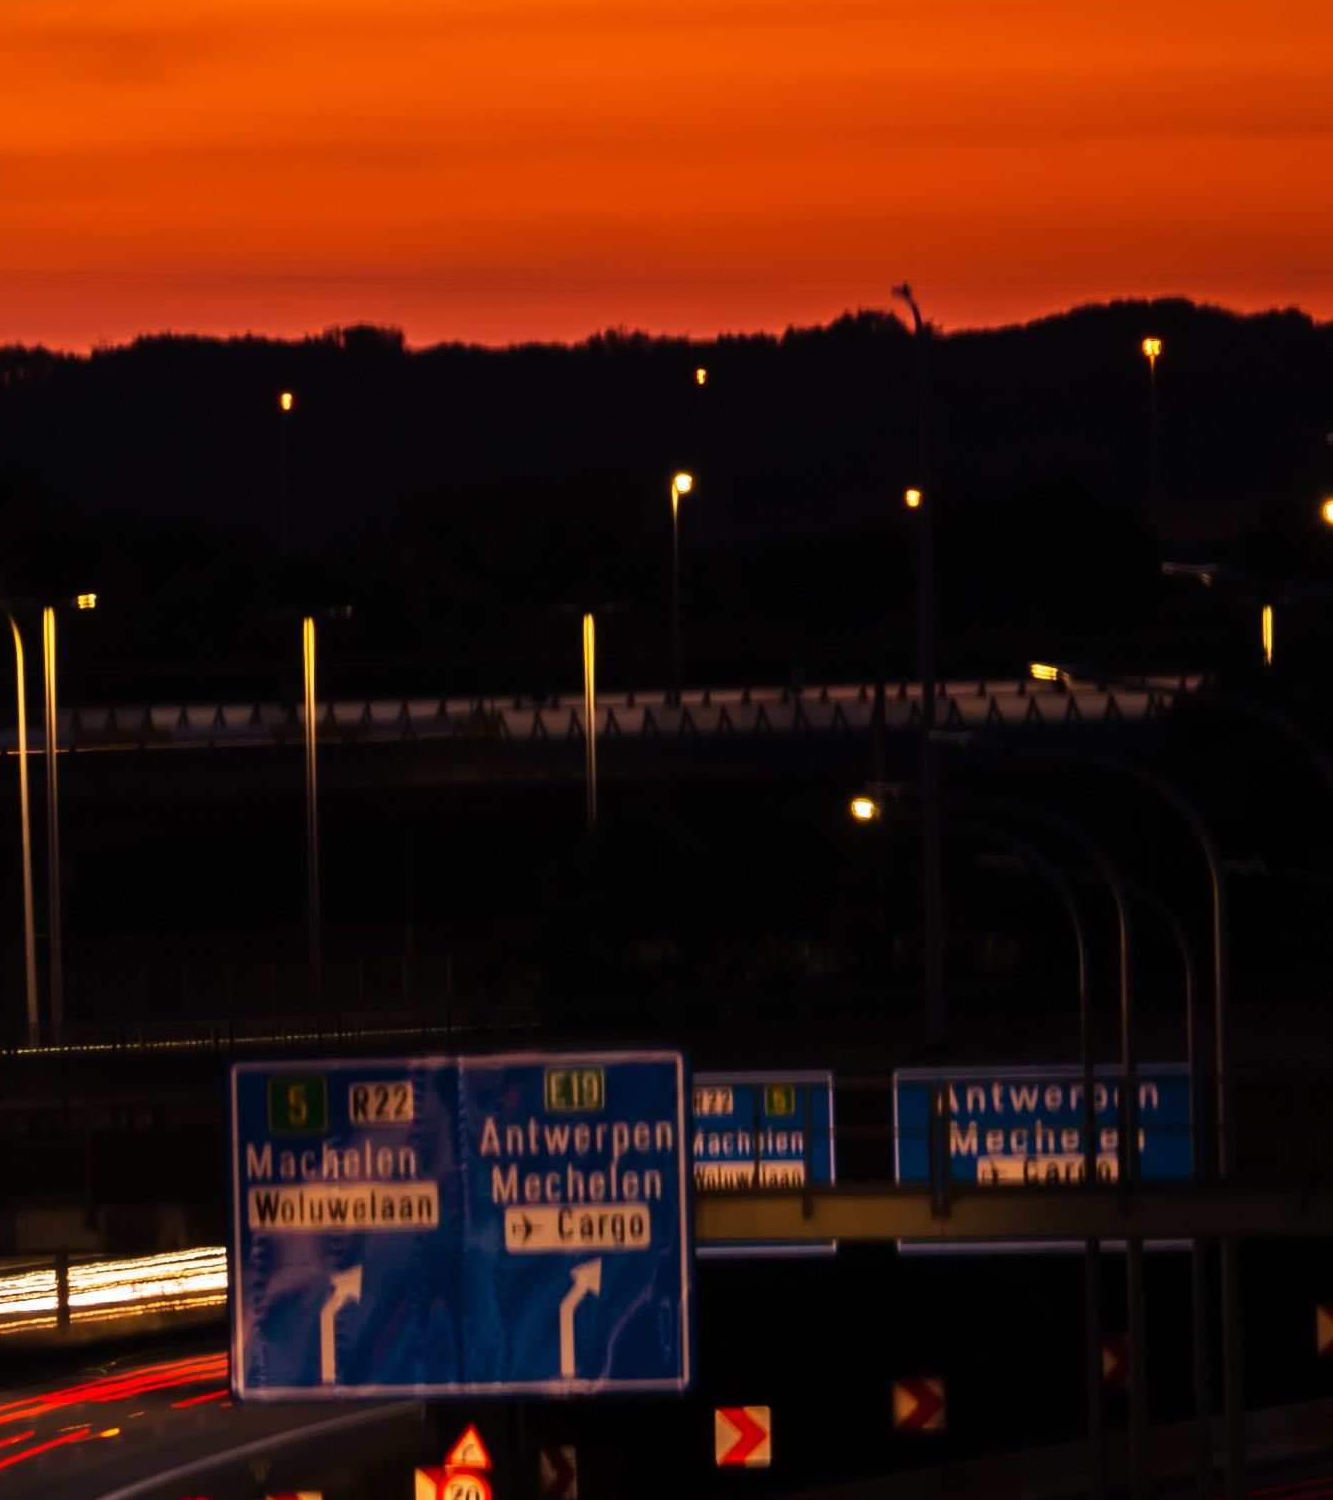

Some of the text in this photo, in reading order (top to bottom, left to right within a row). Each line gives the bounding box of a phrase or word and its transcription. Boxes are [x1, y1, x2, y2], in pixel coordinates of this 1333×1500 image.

[288, 1083, 409, 1125] 5 R22
[480, 1116, 673, 1161] Antwerpen
[246, 1139, 417, 1181] Machelen
[492, 1162, 662, 1204] Mechelen
[254, 1188, 433, 1225] Woluwelaan
[558, 1206, 645, 1247] Cargo
